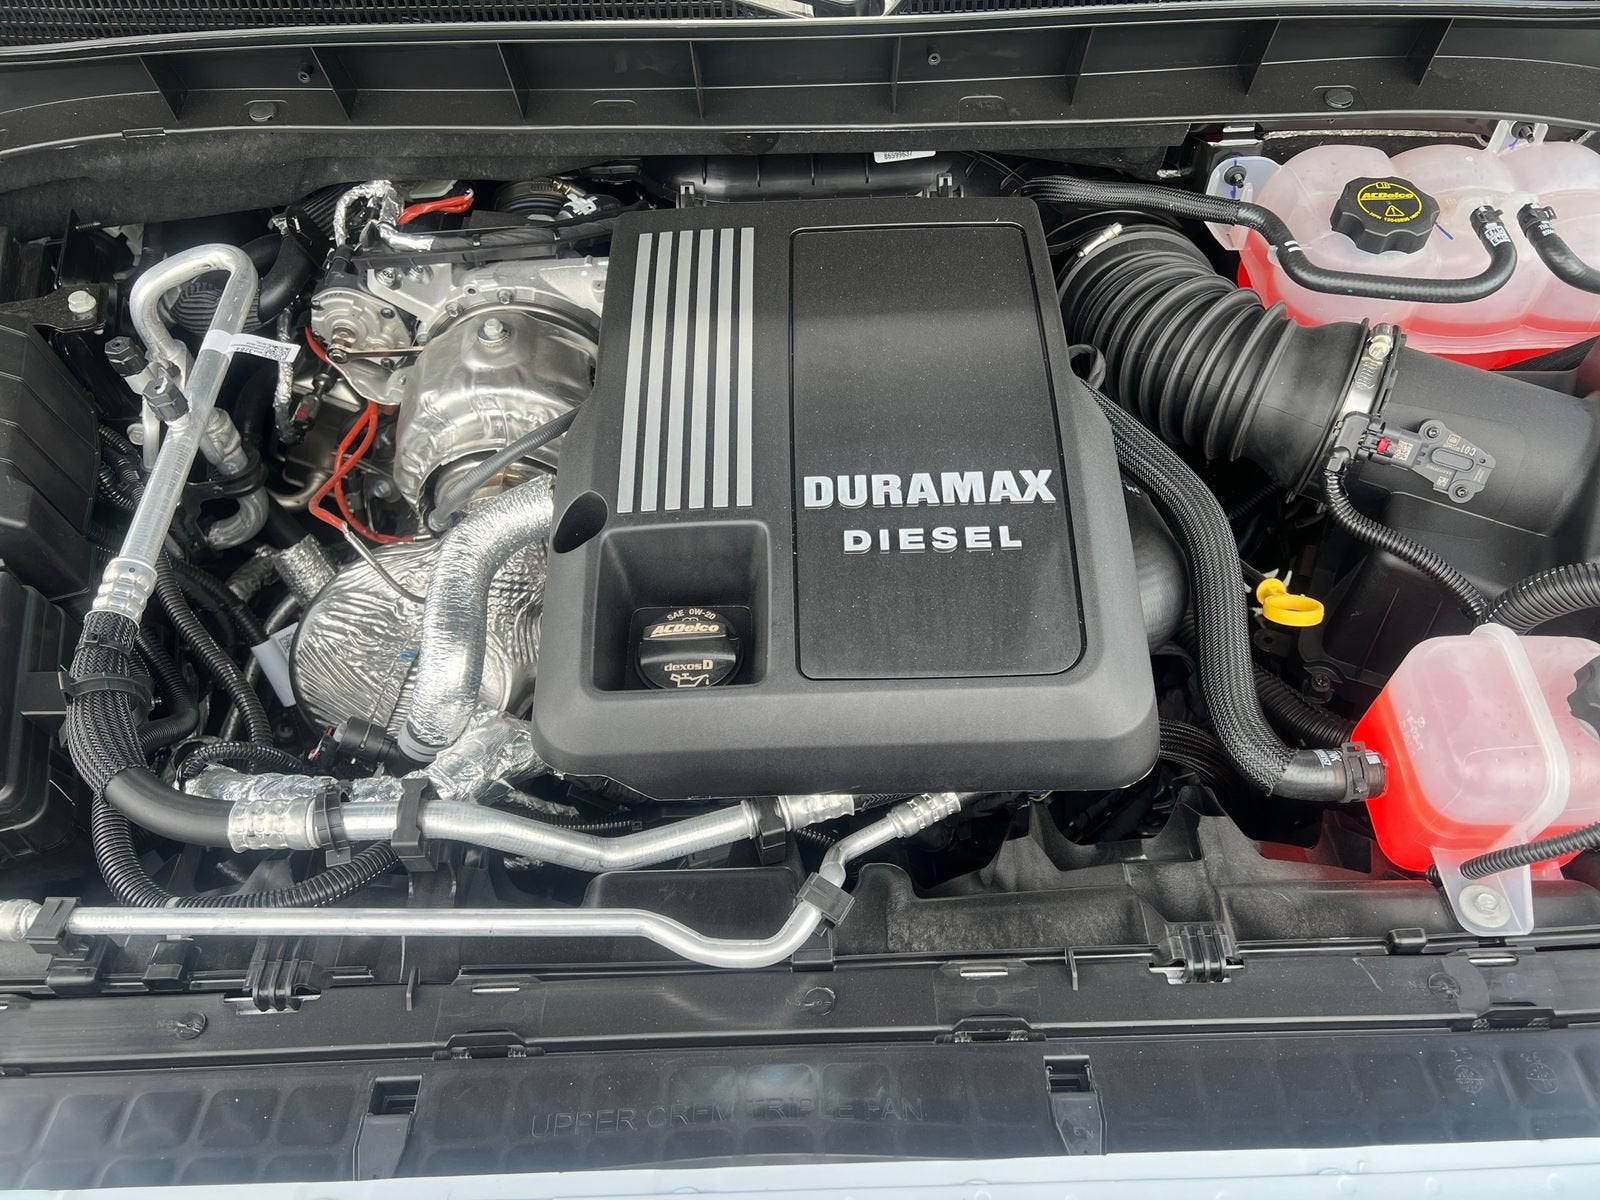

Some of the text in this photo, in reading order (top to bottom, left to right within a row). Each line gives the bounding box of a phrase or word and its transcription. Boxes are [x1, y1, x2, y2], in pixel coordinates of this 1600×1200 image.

[1360, 192, 1415, 200] ACDelco
[804, 470, 1056, 508] DURAMAX
[843, 526, 1022, 554] DIESEL
[667, 607, 716, 621] SAE 0W-20
[650, 623, 720, 637] ACDelco
[530, 1106, 638, 1138] UPPER
[863, 1096, 924, 1122] FAN
